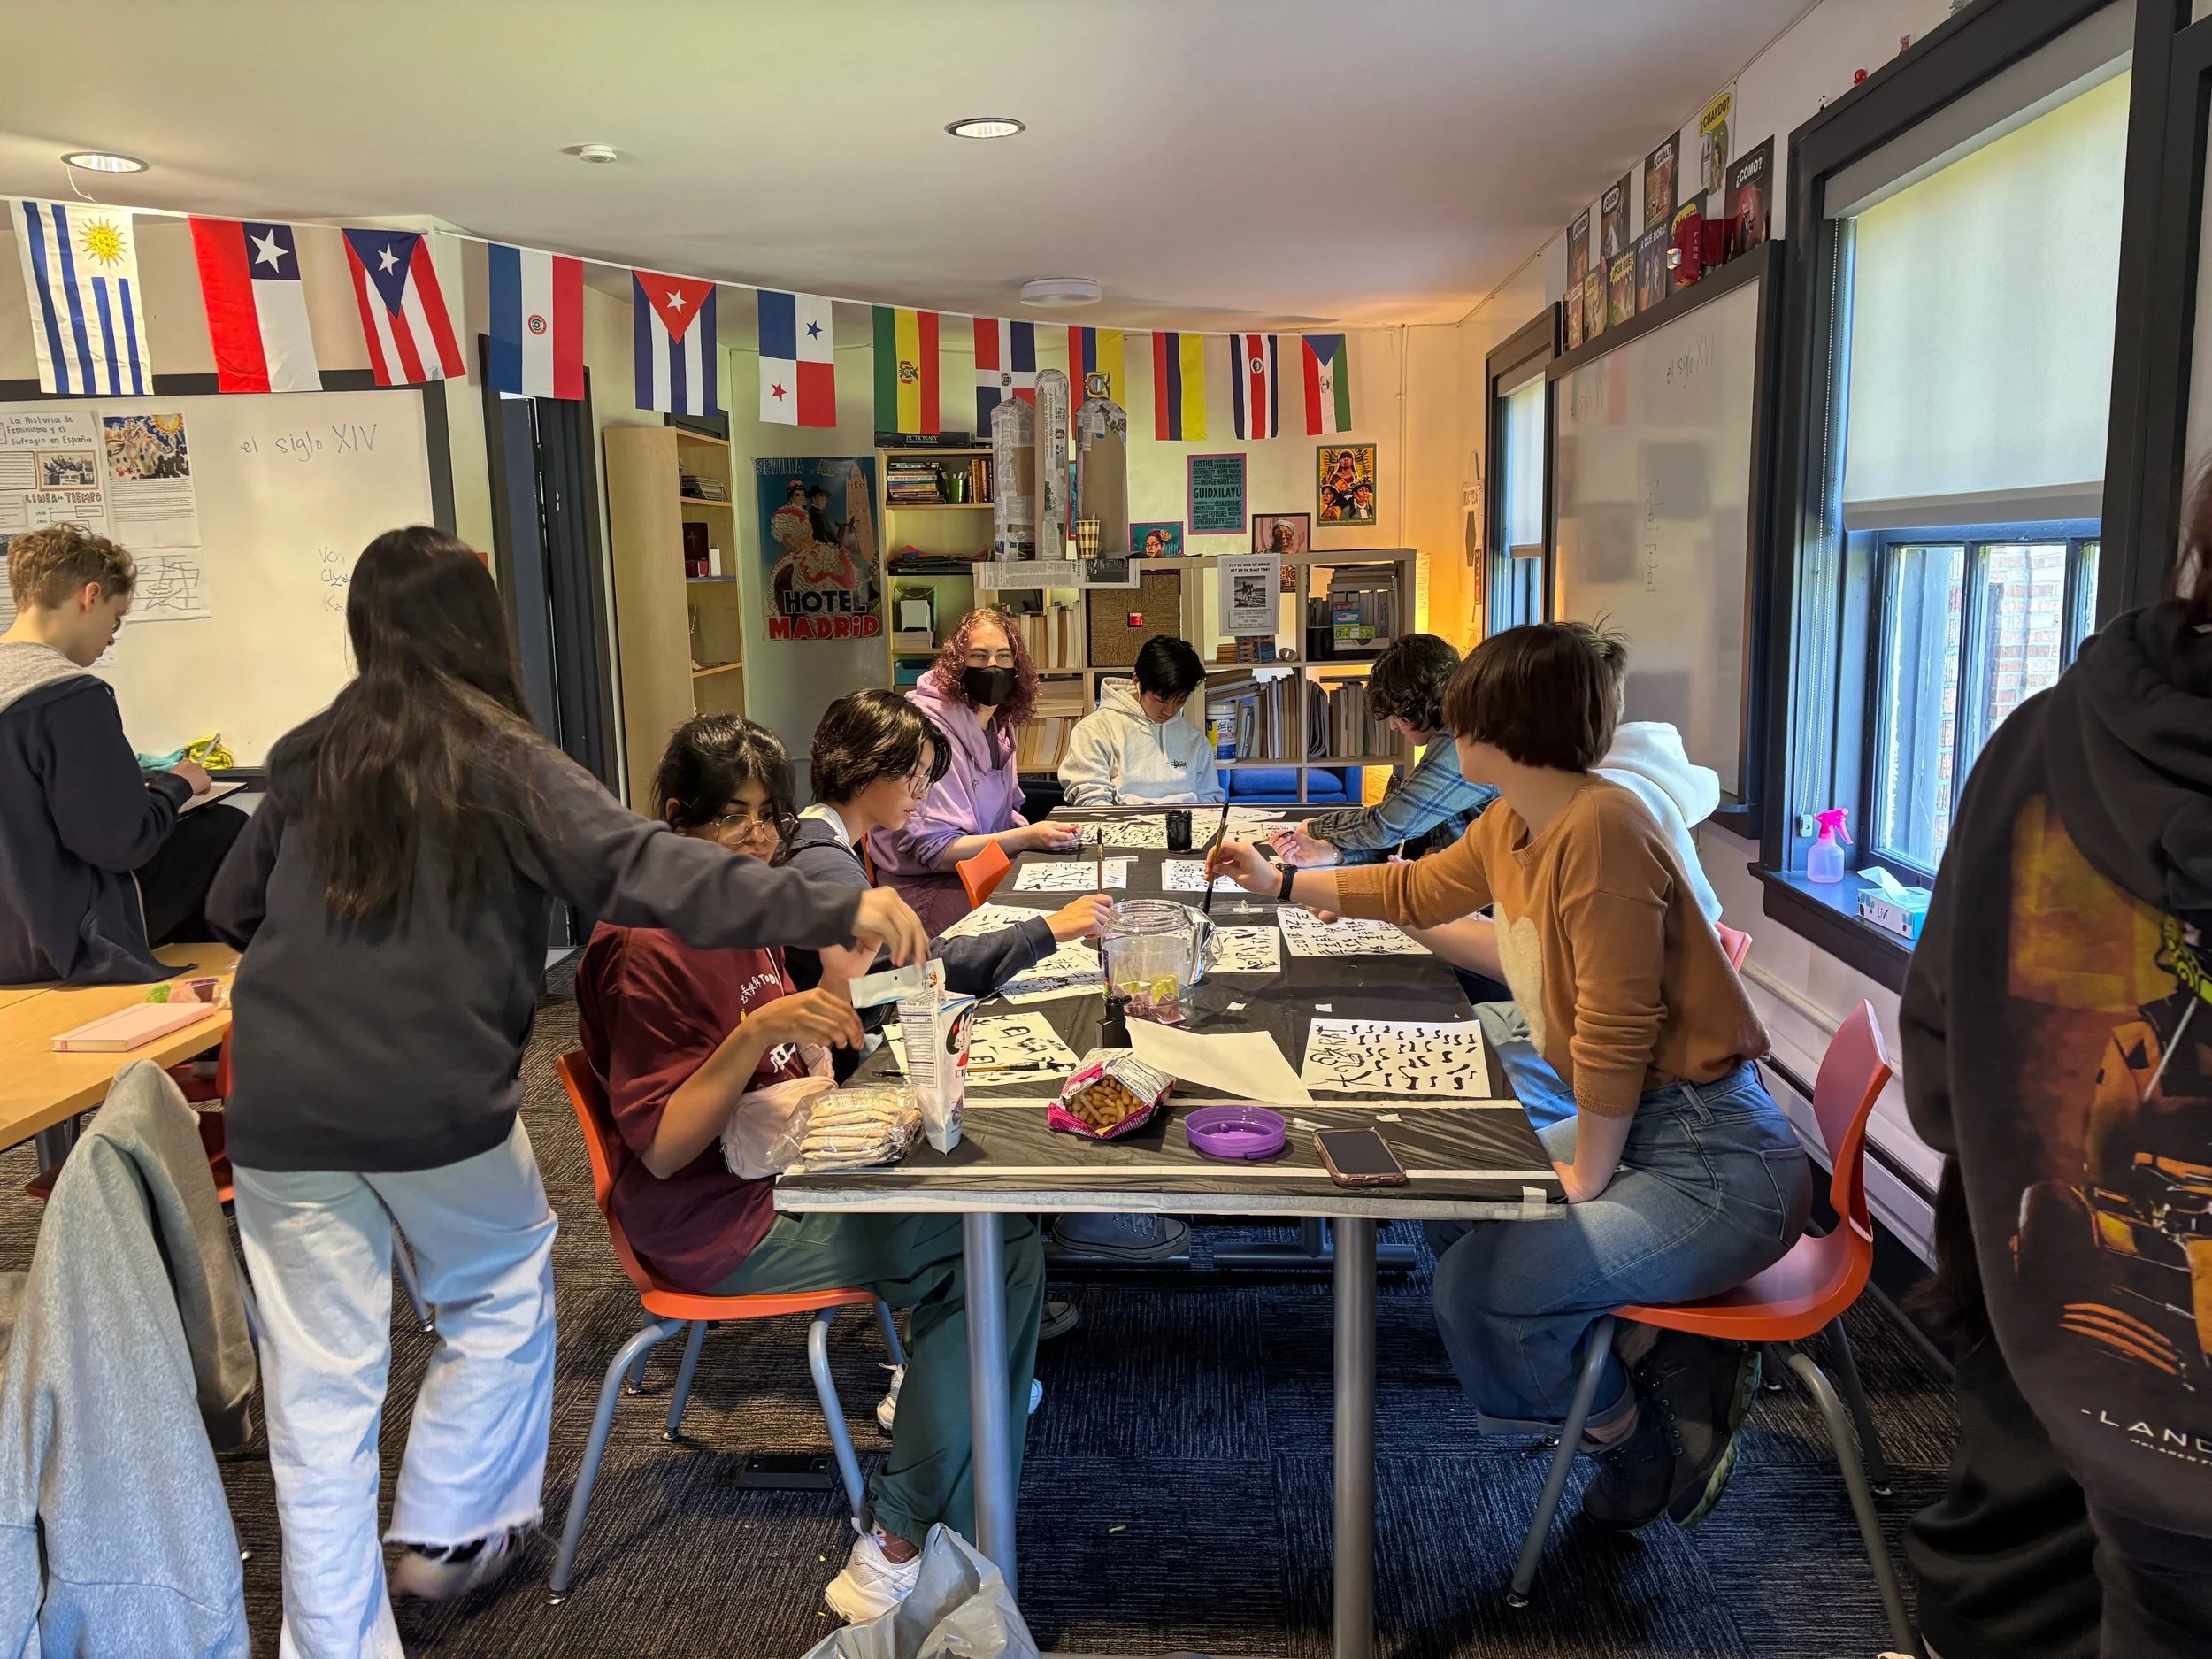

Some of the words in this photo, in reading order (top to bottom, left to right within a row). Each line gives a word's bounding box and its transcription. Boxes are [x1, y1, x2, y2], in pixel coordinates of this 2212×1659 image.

[25, 415, 61, 424] Historia
[63, 434, 93, 446] España
[241, 436, 258, 453] el
[275, 431, 323, 462] siglo
[332, 423, 378, 453] XIV
[757, 458, 803, 475] SEVILLA
[1193, 459, 1214, 468] JUSTICE
[64, 492, 102, 503] TIEMPO
[1193, 485, 1242, 498] GUIDXILAYÚ
[784, 590, 867, 613] HOTEL
